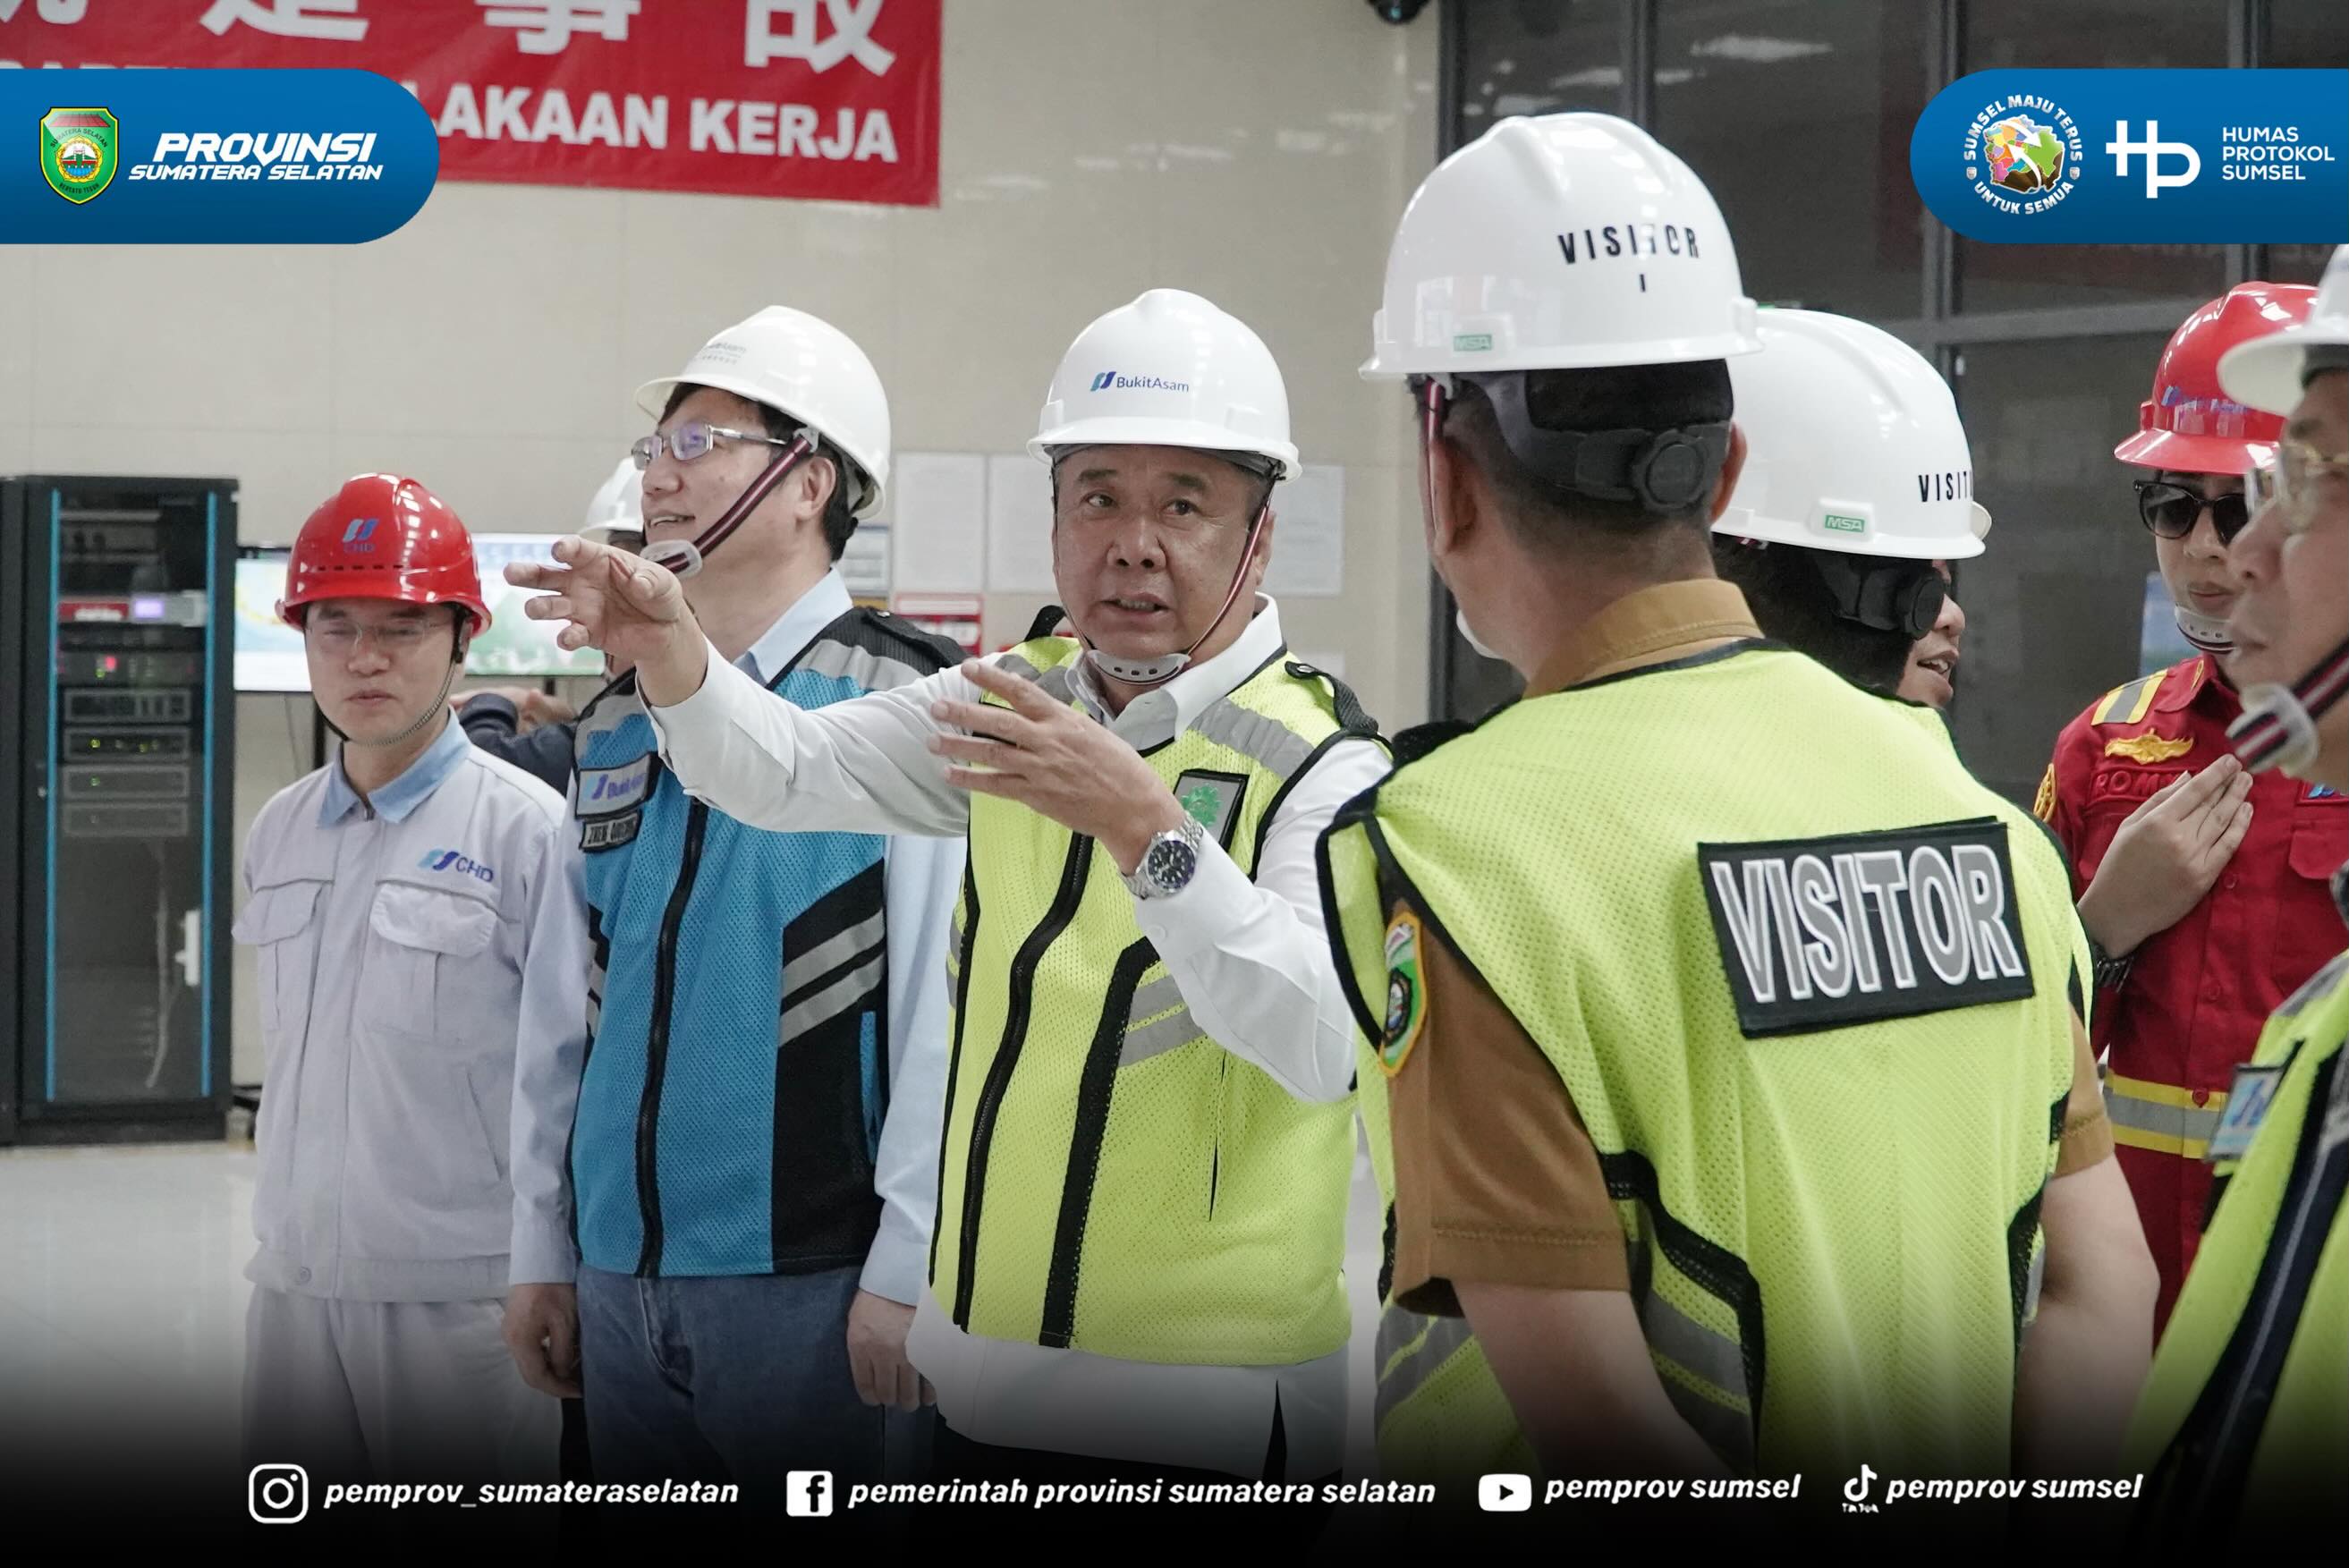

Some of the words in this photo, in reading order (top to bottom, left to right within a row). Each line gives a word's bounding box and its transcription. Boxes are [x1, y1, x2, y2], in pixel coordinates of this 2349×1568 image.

[689, 98, 899, 164] KERJA
[1115, 376, 1190, 393] BukitAsam
[1827, 515, 1863, 531] MSA
[455, 856, 495, 883] CHD
[1709, 844, 2025, 1004] VISITOR
